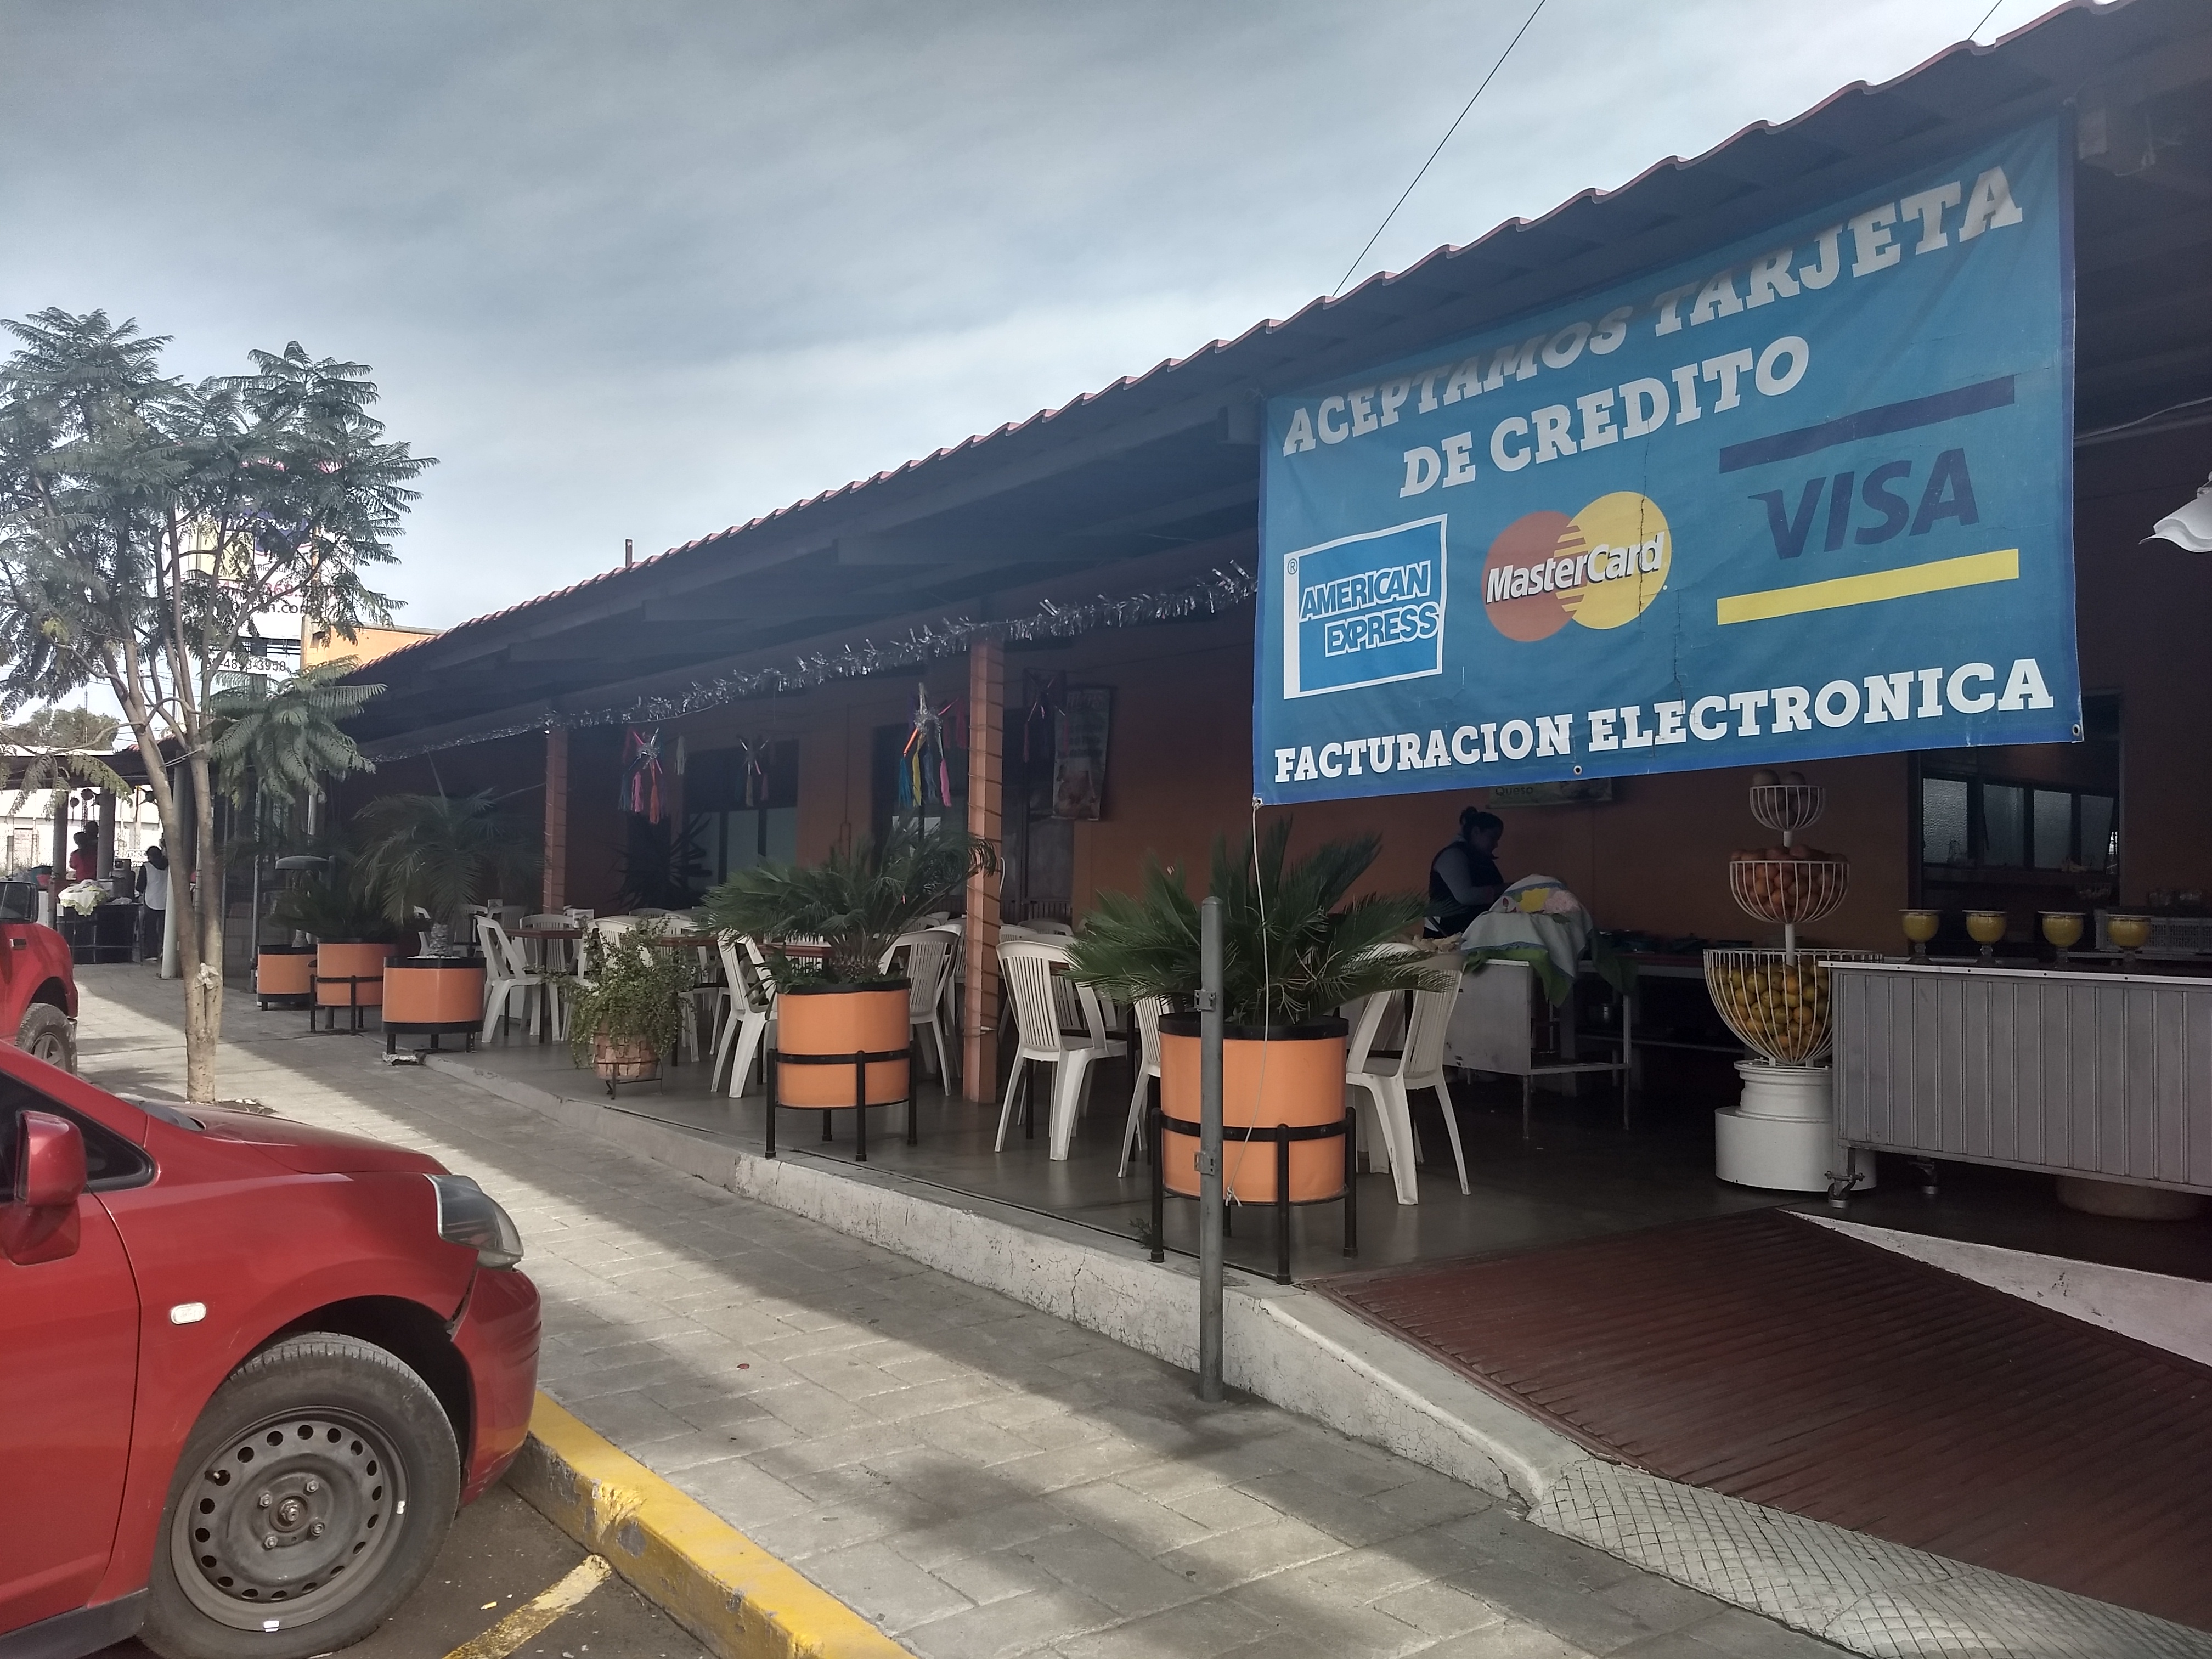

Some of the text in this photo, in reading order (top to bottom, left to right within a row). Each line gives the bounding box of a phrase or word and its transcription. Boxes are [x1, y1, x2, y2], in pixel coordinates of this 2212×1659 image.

[1283, 165, 2023, 457] ACEPTAMOS TARJETA
[1400, 335, 1809, 498] DE CREDITO
[1748, 448, 1980, 560] VISA
[1299, 560, 1431, 622] AMERICAN
[1486, 531, 1665, 605] MasterCard
[1325, 601, 1441, 657] EXPRESS
[1274, 658, 2053, 783] FACTURACION ELECTRONICA
[1496, 786, 1533, 796] Queso
